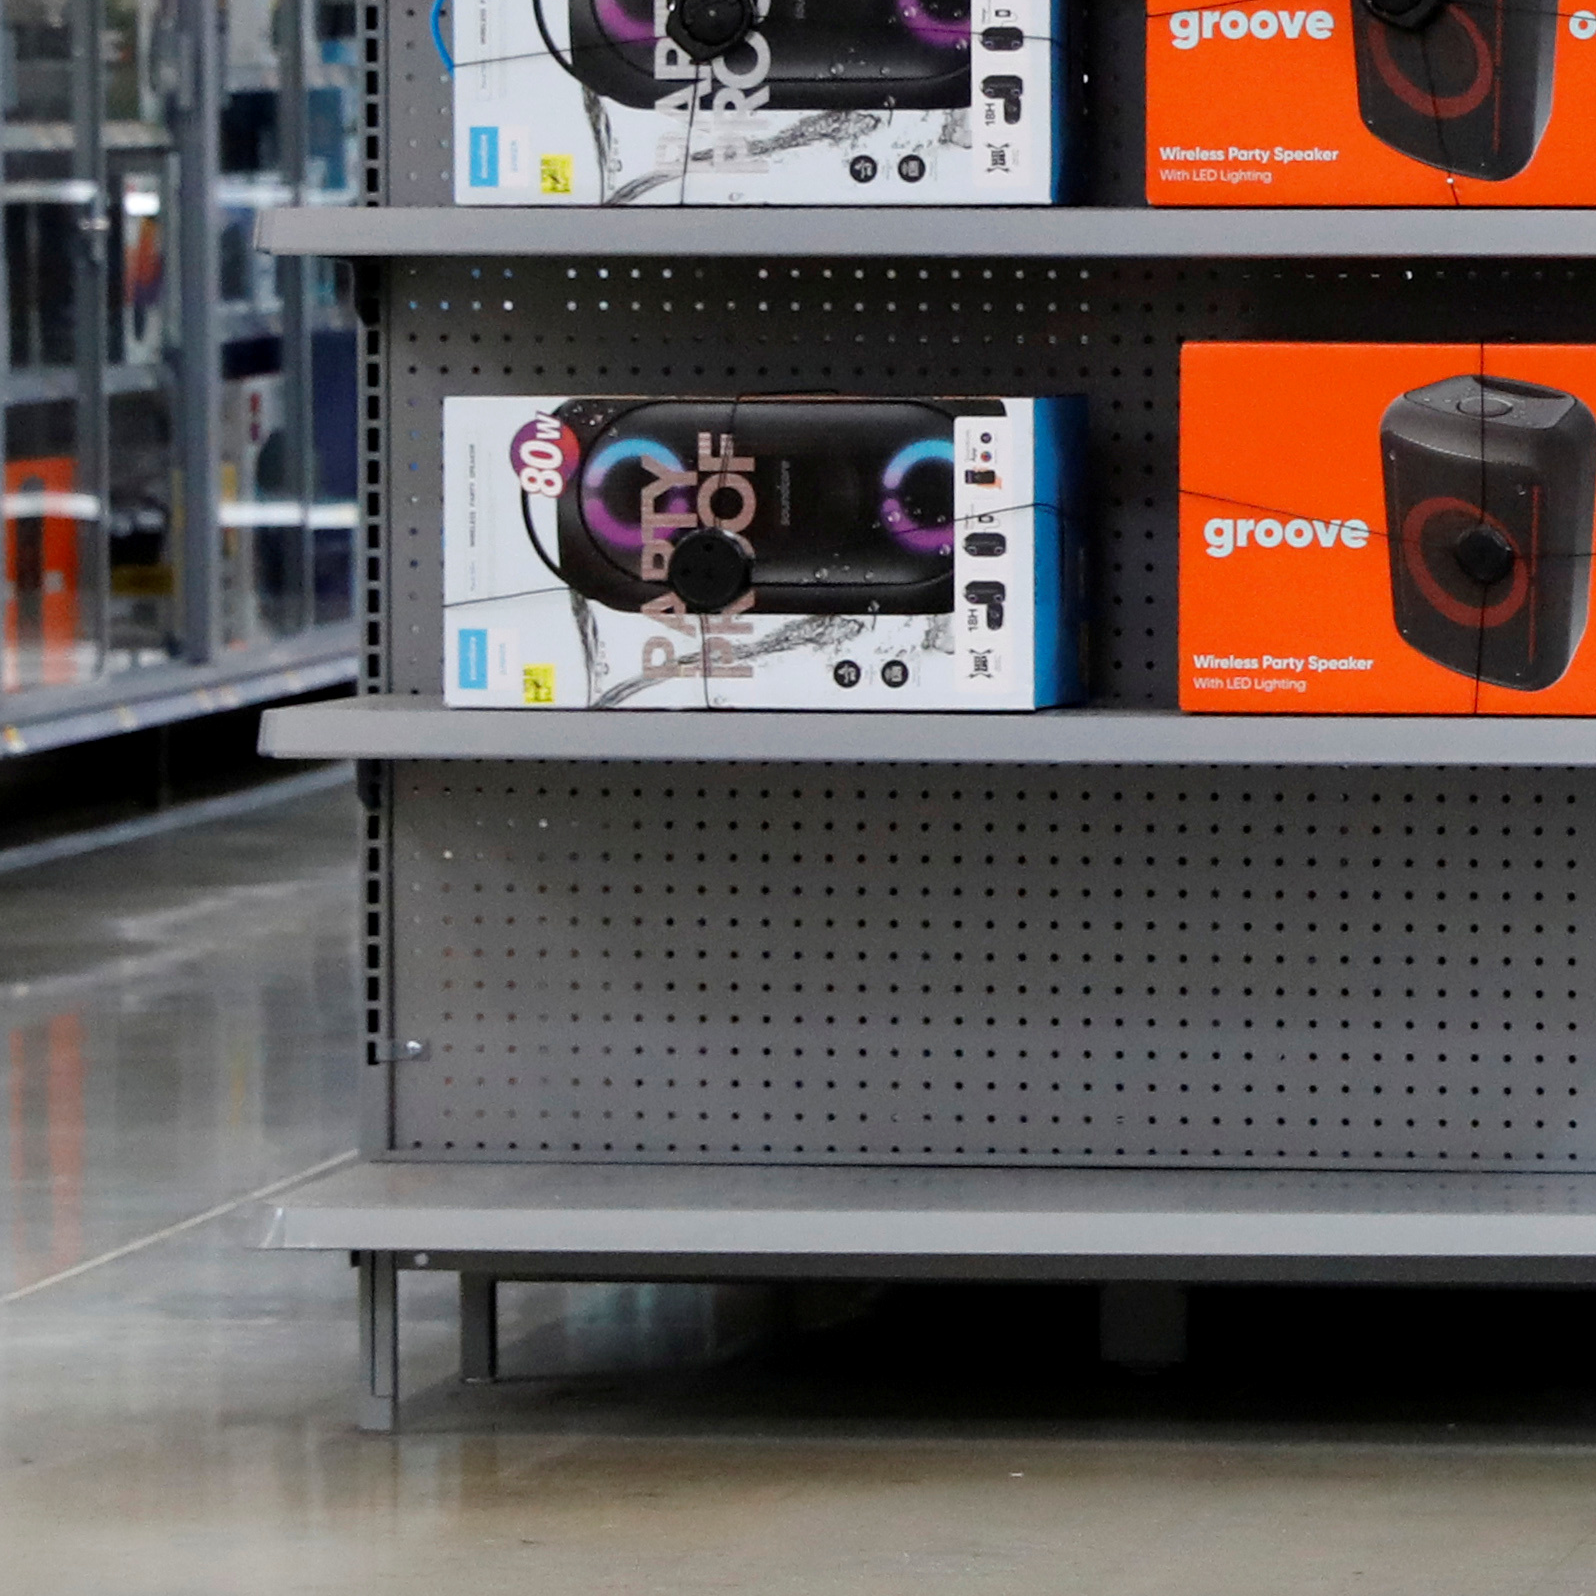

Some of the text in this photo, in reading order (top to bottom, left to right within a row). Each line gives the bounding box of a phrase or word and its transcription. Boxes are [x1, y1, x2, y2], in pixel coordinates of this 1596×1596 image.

[1169, 7, 1335, 50] groove
[1159, 145, 1339, 166] Wireless Party Speaker
[1159, 167, 1272, 185] With LED Lighting
[1203, 515, 1370, 557] groove
[698, 431, 755, 679] PROF
[1193, 655, 1374, 674] Wireless Party Speaker
[1193, 676, 1307, 694] With LED Lighting
